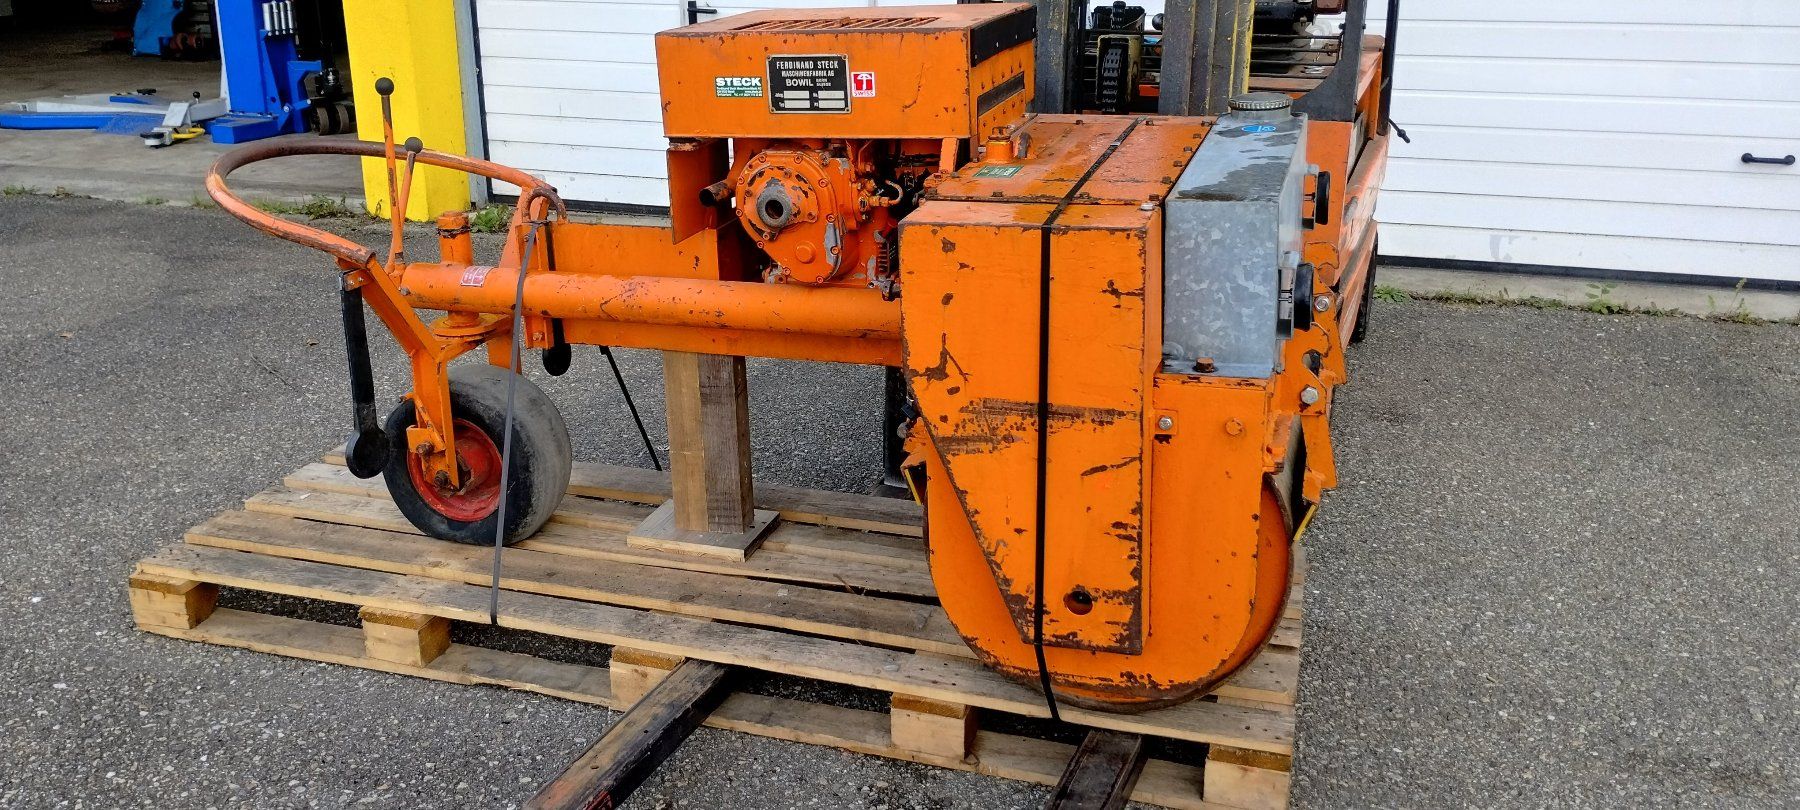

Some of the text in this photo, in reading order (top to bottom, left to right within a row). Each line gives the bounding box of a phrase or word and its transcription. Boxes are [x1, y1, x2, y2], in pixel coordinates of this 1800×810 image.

[776, 60, 839, 70] FERDINAND STECK
[716, 77, 762, 87] STECK
[785, 78, 814, 87] BOWIL
